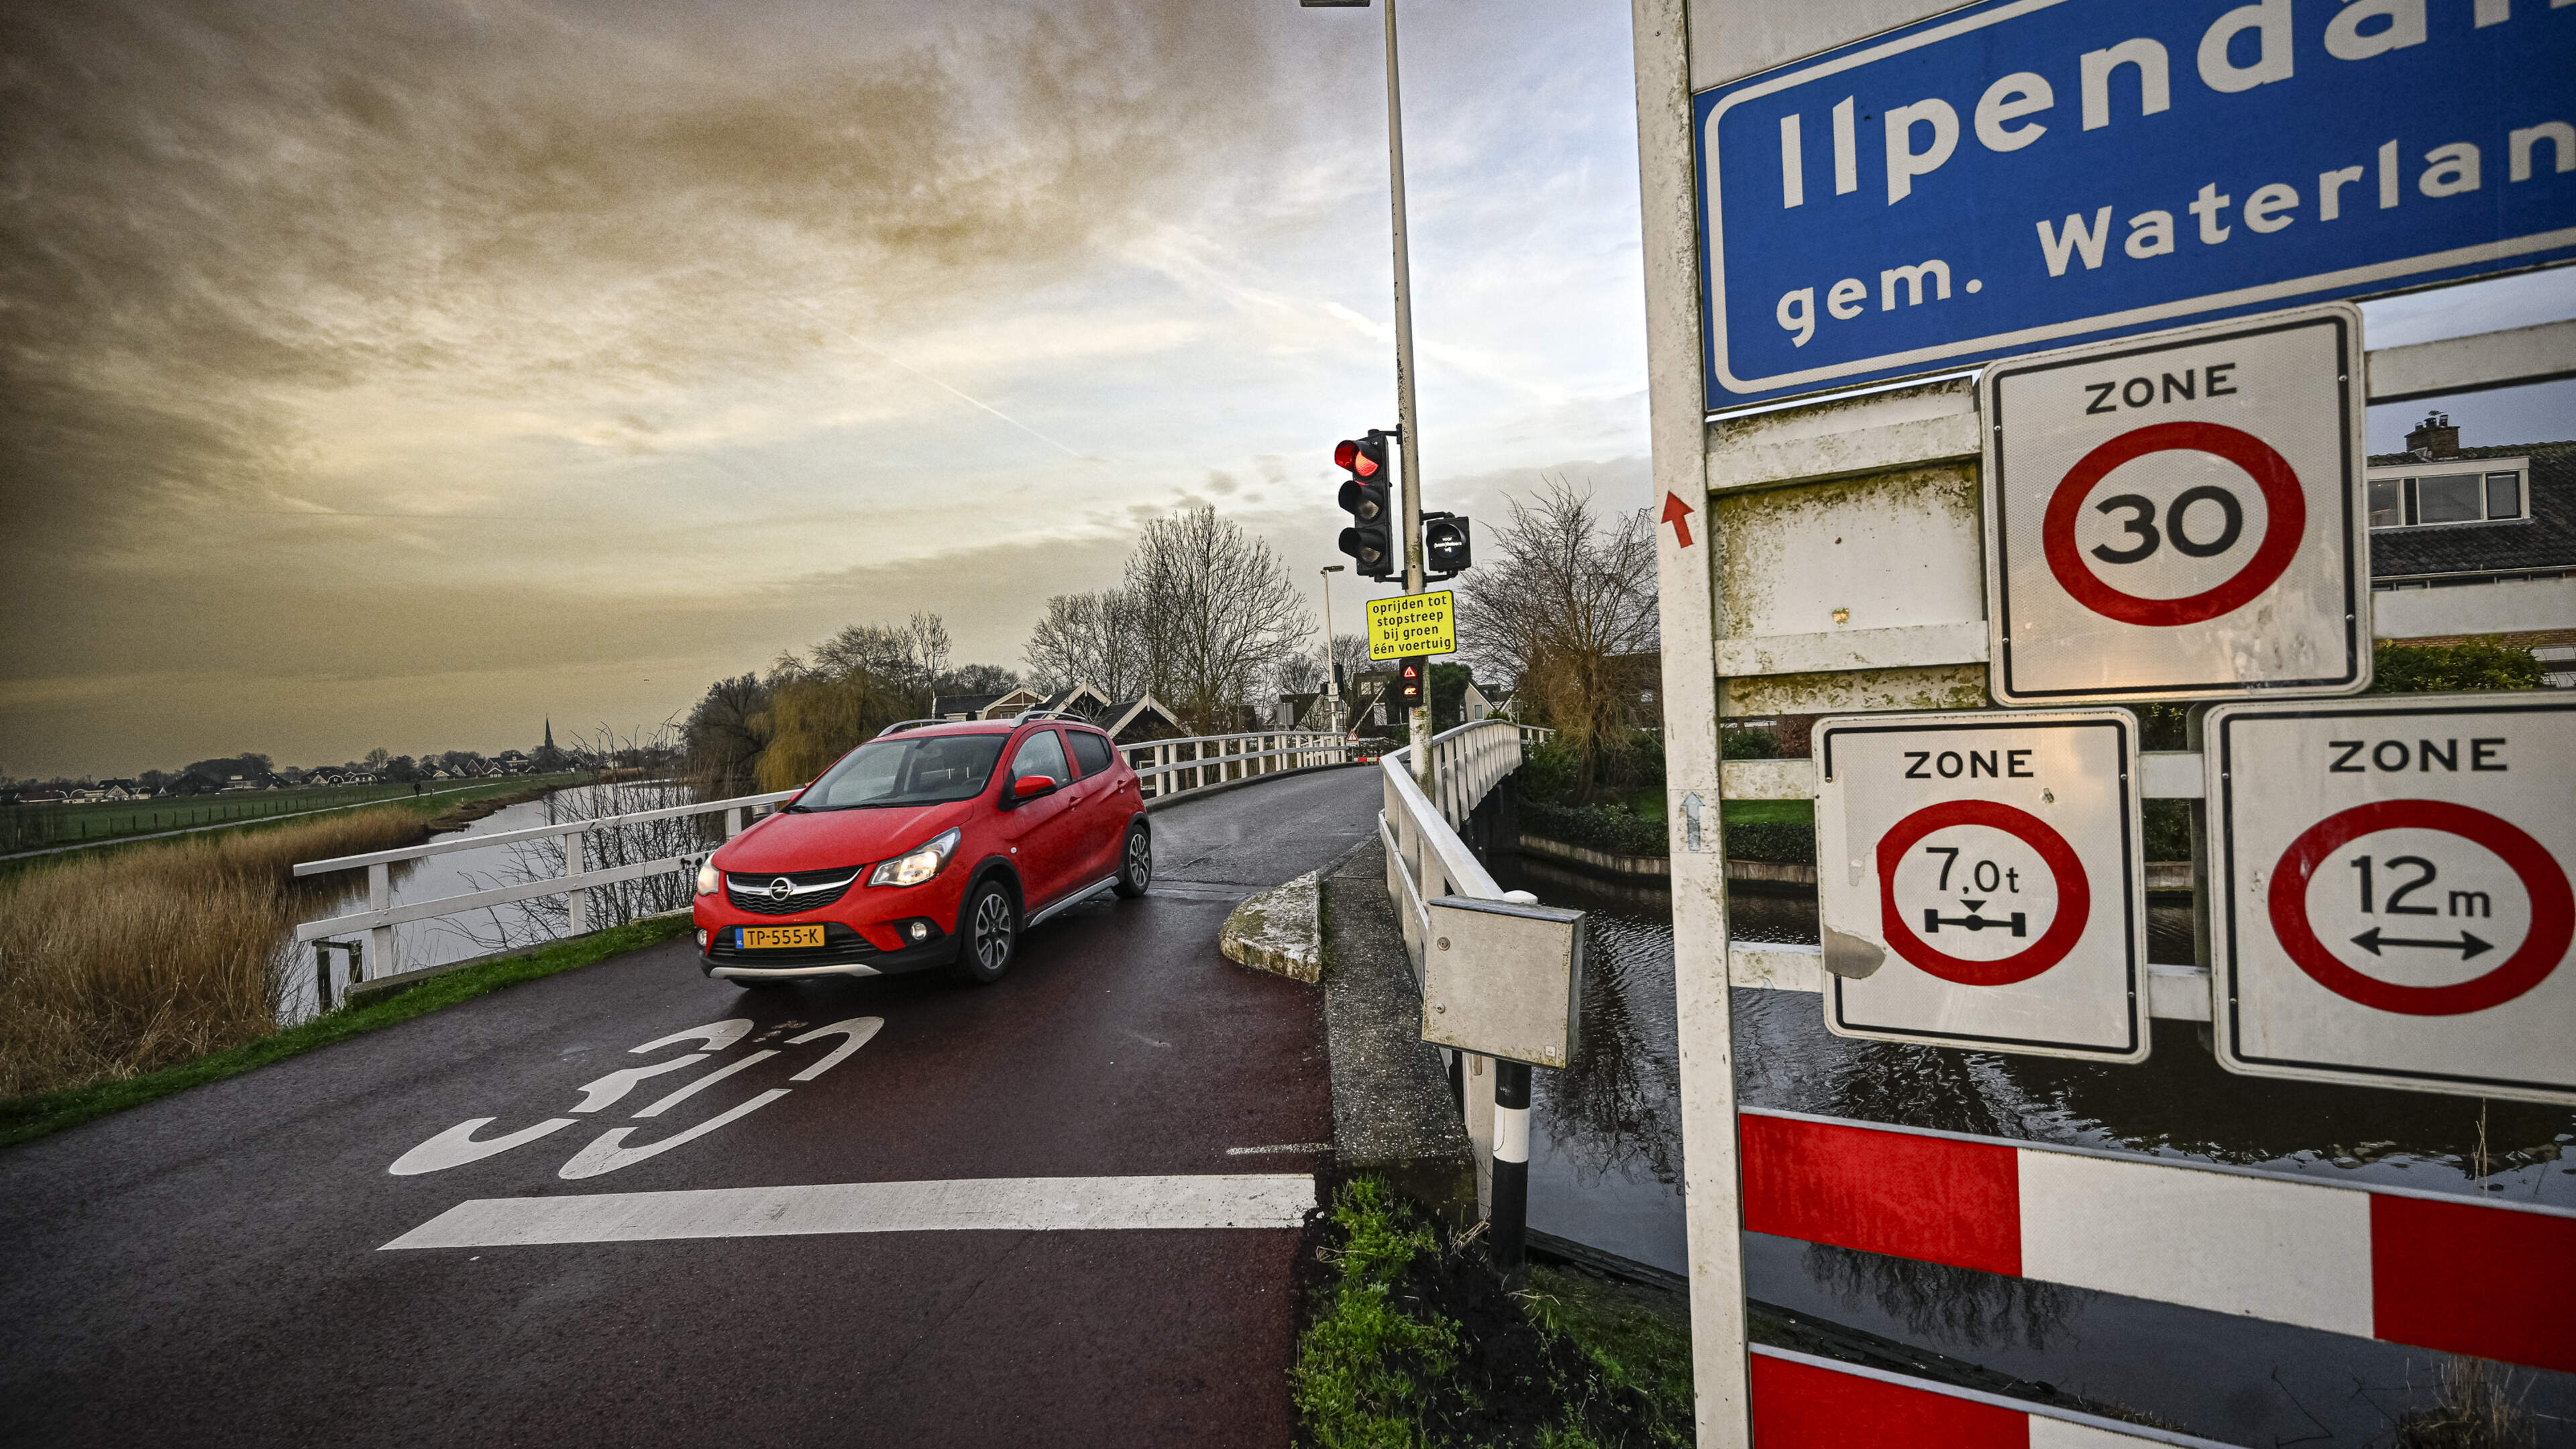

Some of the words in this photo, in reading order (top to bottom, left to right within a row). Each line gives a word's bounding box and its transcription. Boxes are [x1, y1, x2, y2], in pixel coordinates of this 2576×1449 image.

[1780, 0, 2576, 209] Ilpenda
[1776, 259, 1983, 349] gem.
[2035, 121, 2576, 278] Waterlan
[2084, 362, 2237, 415] ZONE
[2090, 485, 2243, 564] 30
[1373, 599, 1424, 615] oprijden
[1428, 595, 1447, 607] tot
[1377, 611, 1444, 627] stopstreep
[1373, 643, 1395, 654] één
[1399, 637, 1451, 651] voertuig
[1383, 628, 1399, 641] bij
[1403, 625, 1438, 641] groen
[1904, 749, 2034, 779] ZONE
[2328, 737, 2508, 773] ZONE
[747, 928, 819, 945] TP-555-K
